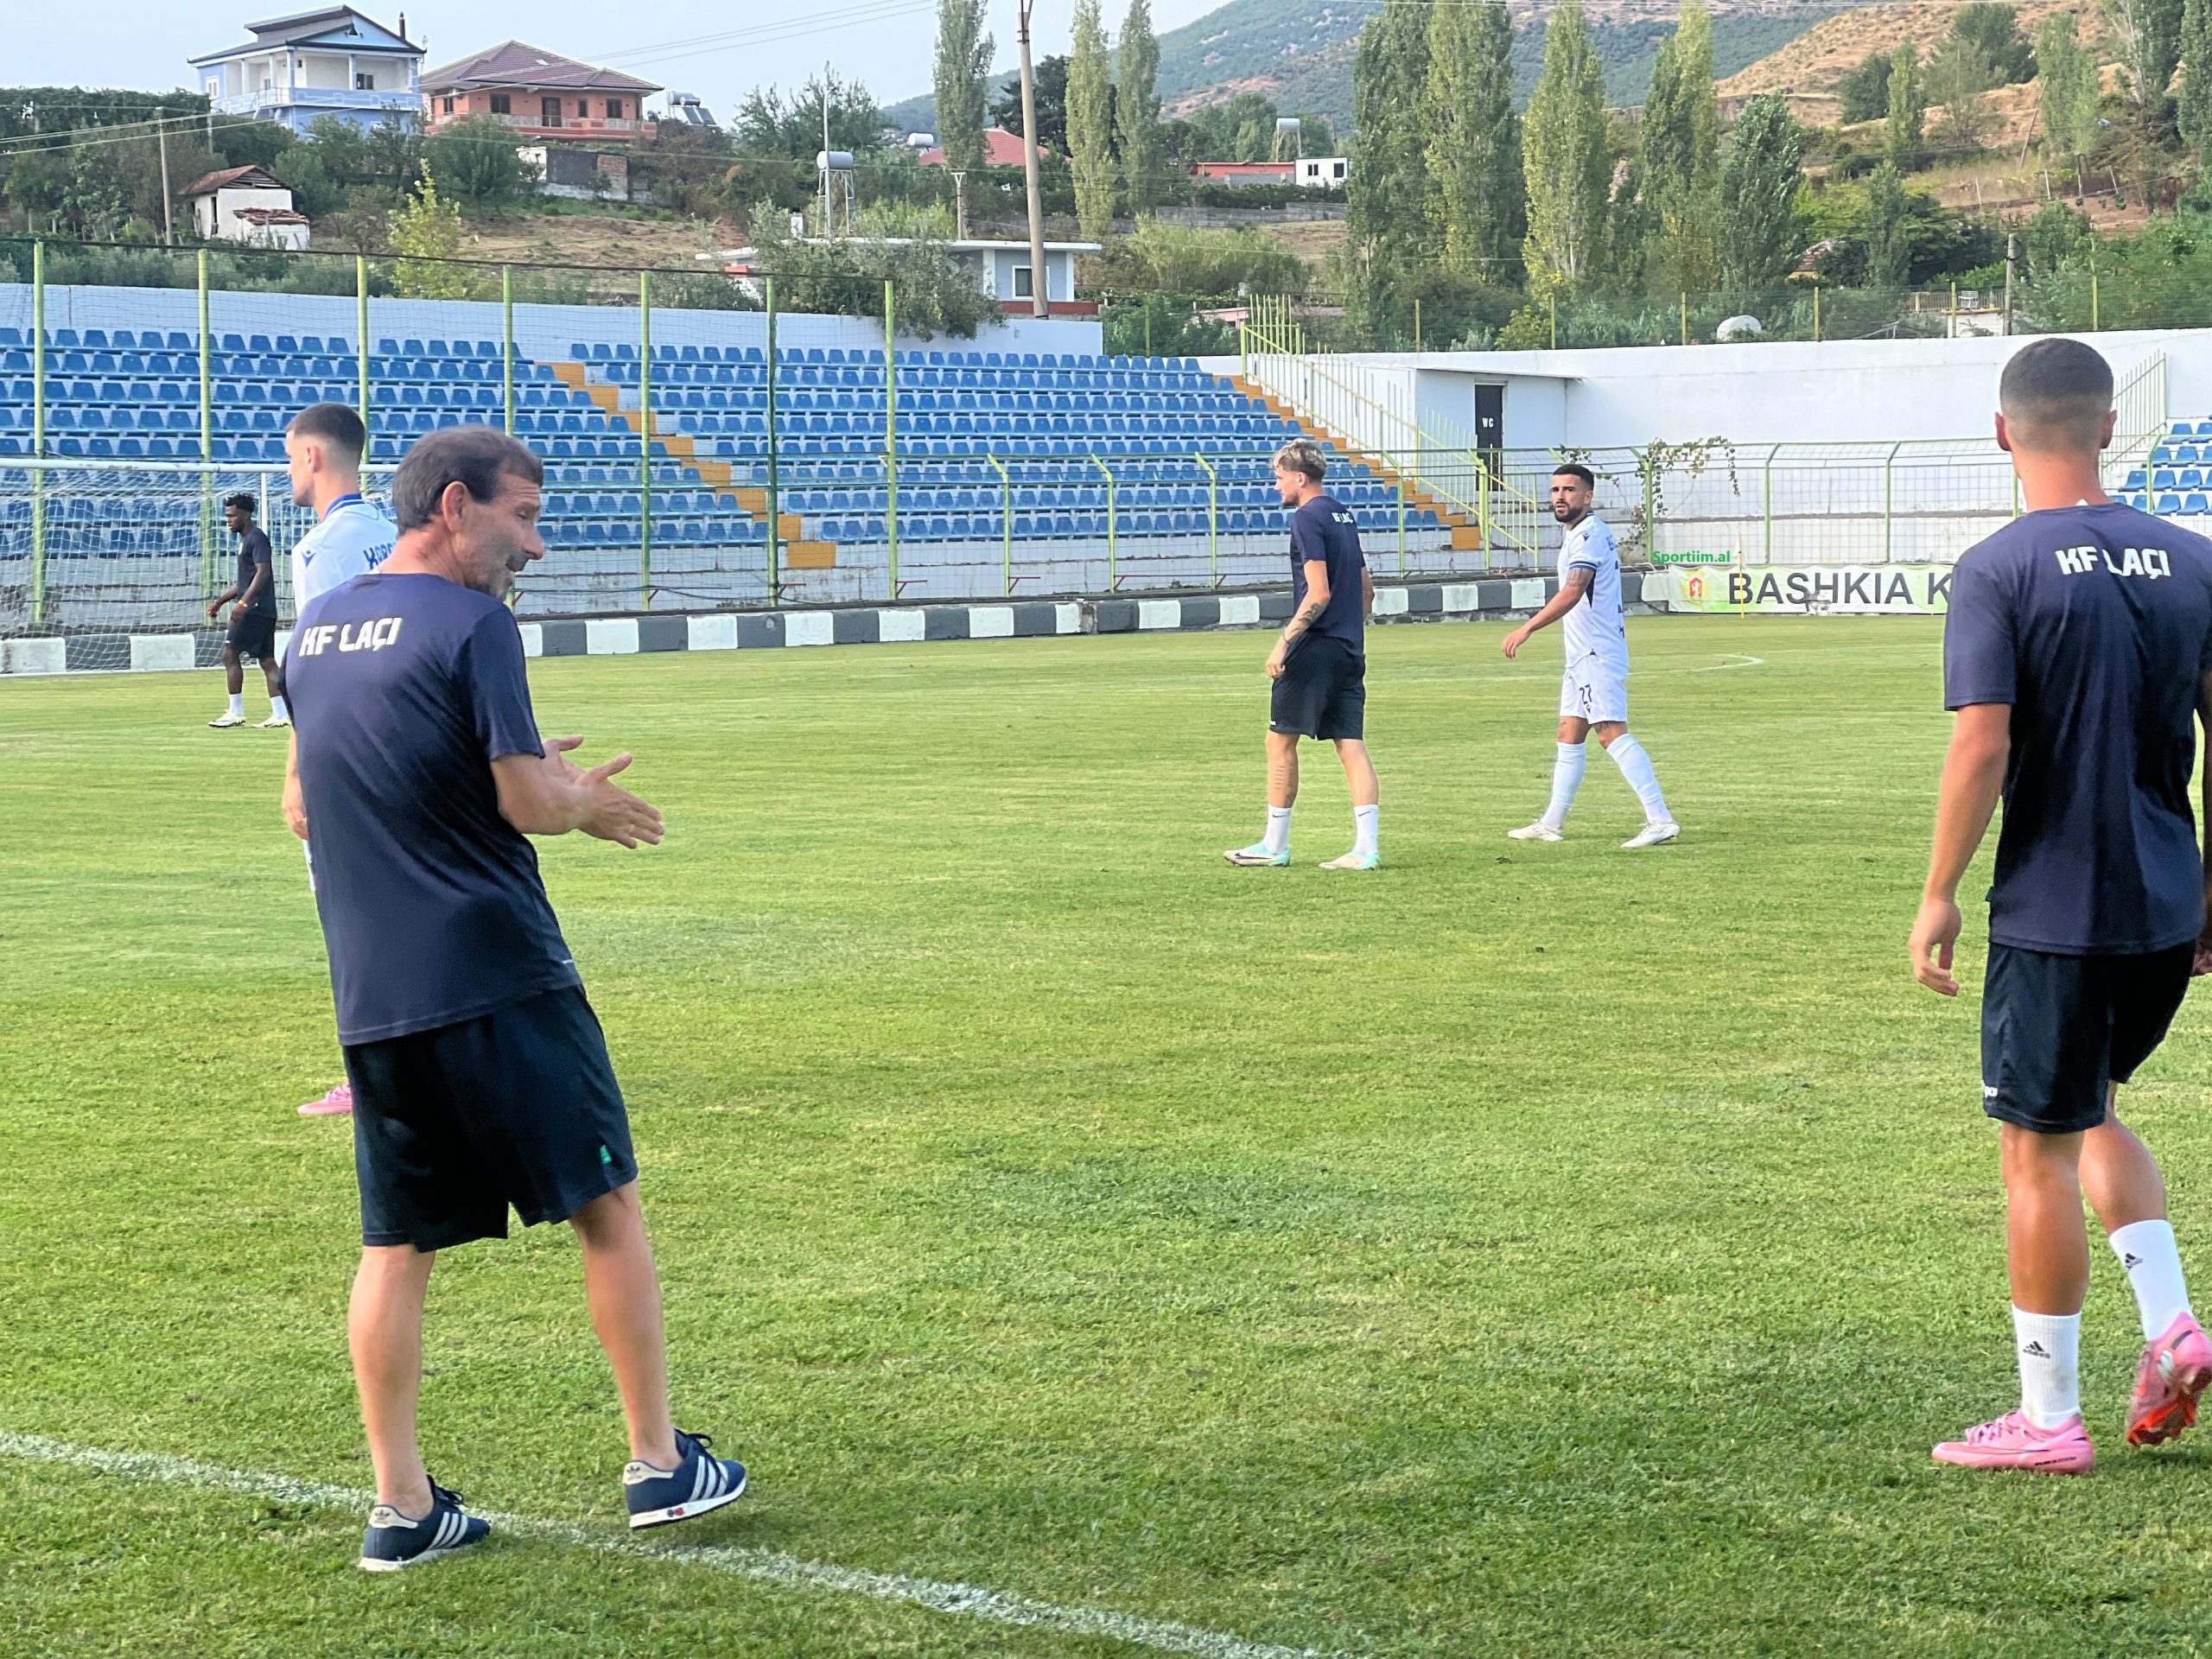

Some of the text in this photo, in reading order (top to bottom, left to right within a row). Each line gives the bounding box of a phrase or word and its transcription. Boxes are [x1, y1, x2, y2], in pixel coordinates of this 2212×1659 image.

[1482, 417, 1494, 428] WC
[2055, 546, 2171, 580] KF LAÇI
[1728, 572, 1914, 605] BASHKIA
[298, 617, 404, 657] KF LAÇI
[1579, 683, 1592, 705] 27
